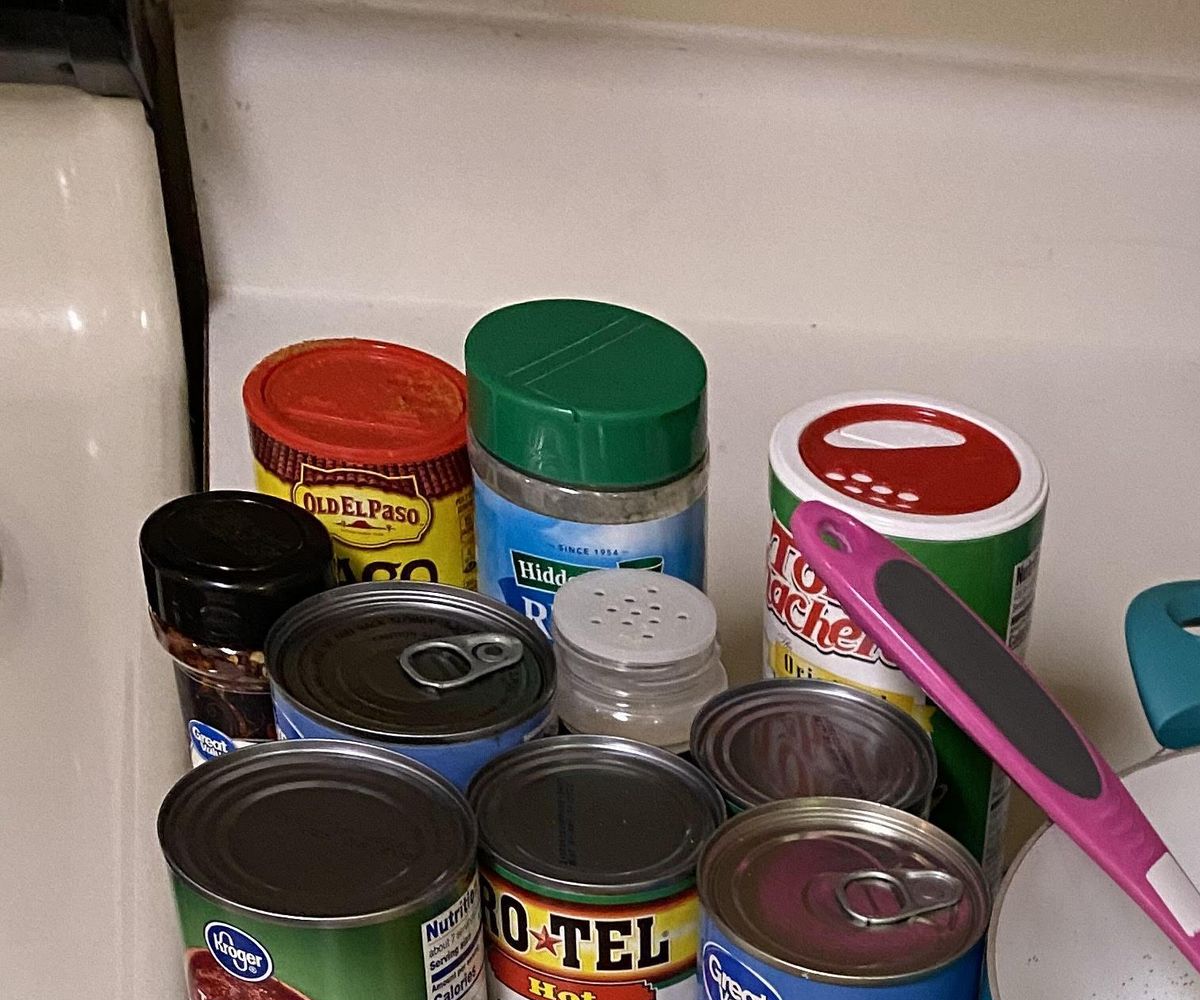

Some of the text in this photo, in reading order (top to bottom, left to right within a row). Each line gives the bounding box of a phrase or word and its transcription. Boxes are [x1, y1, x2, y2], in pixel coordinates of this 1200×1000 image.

[558, 544, 619, 557] SINCE 1954
[212, 930, 263, 973] Kroger
